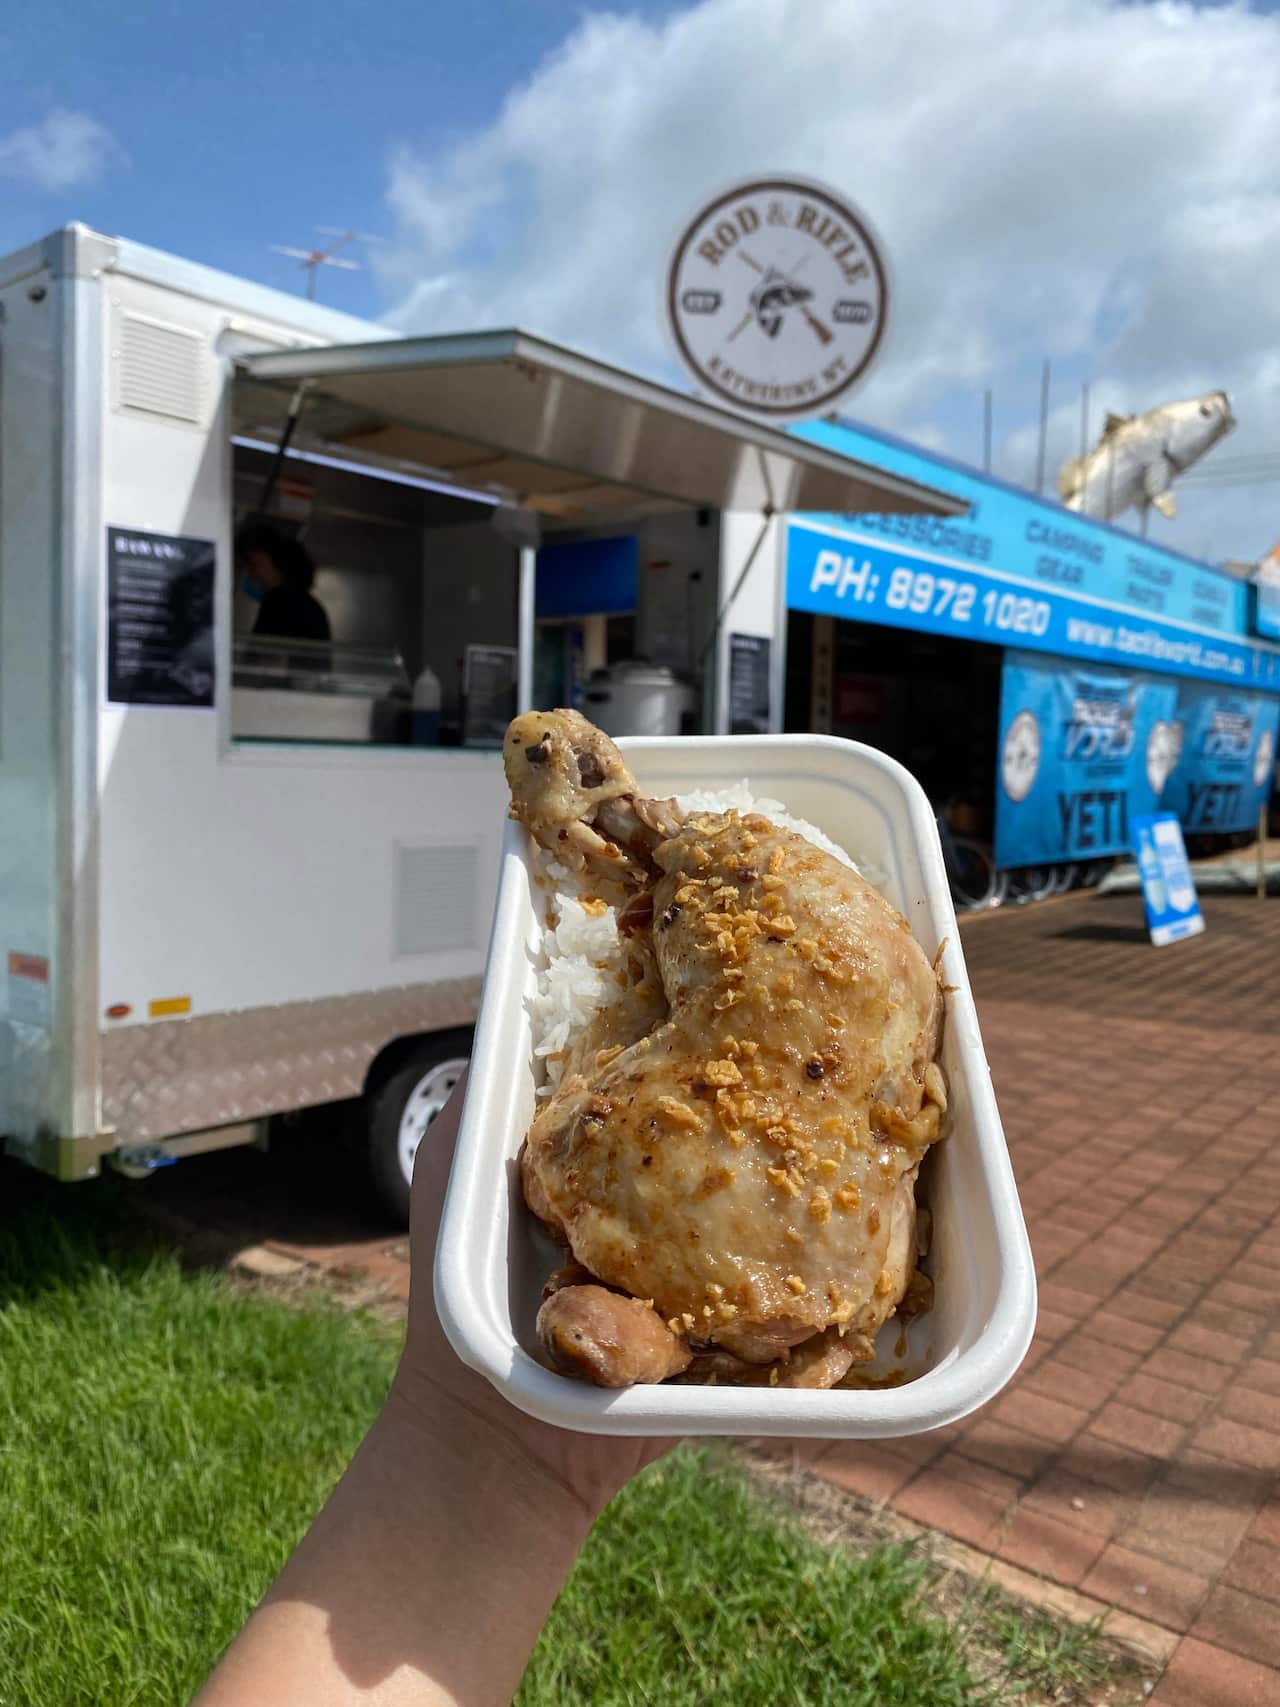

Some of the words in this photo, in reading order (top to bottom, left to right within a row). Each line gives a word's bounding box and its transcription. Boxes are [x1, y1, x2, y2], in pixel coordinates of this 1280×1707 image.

[697, 205, 761, 267] ROD
[797, 204, 870, 285] RIFLE
[810, 549, 880, 603] PH:
[885, 567, 977, 622] 8972
[983, 589, 1051, 637] 1020
[1056, 790, 1127, 849] YETI
[1186, 782, 1242, 827] YETI
